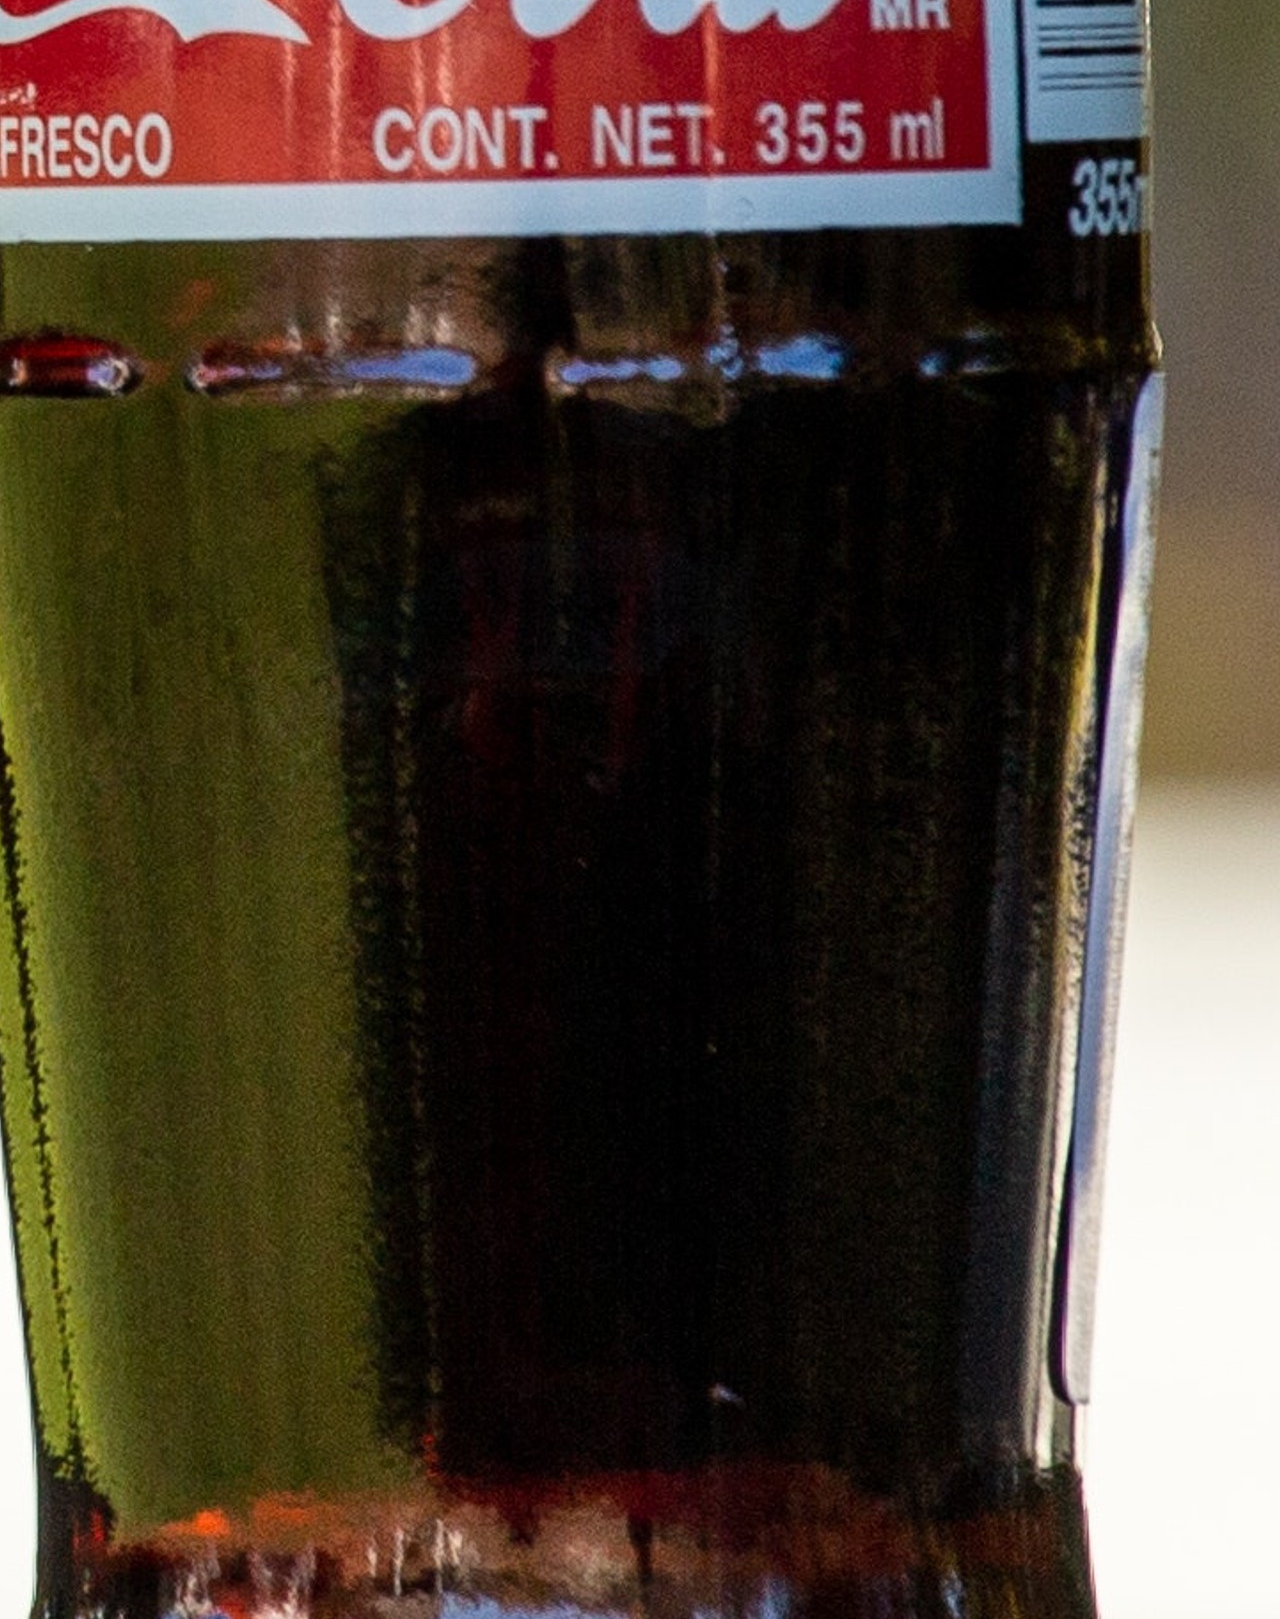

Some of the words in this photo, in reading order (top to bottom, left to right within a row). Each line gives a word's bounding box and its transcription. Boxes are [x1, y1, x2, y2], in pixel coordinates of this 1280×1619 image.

[374, 108, 558, 174] CONT.
[592, 105, 725, 170] NET.
[756, 104, 866, 166] 355
[890, 99, 946, 164] ml
